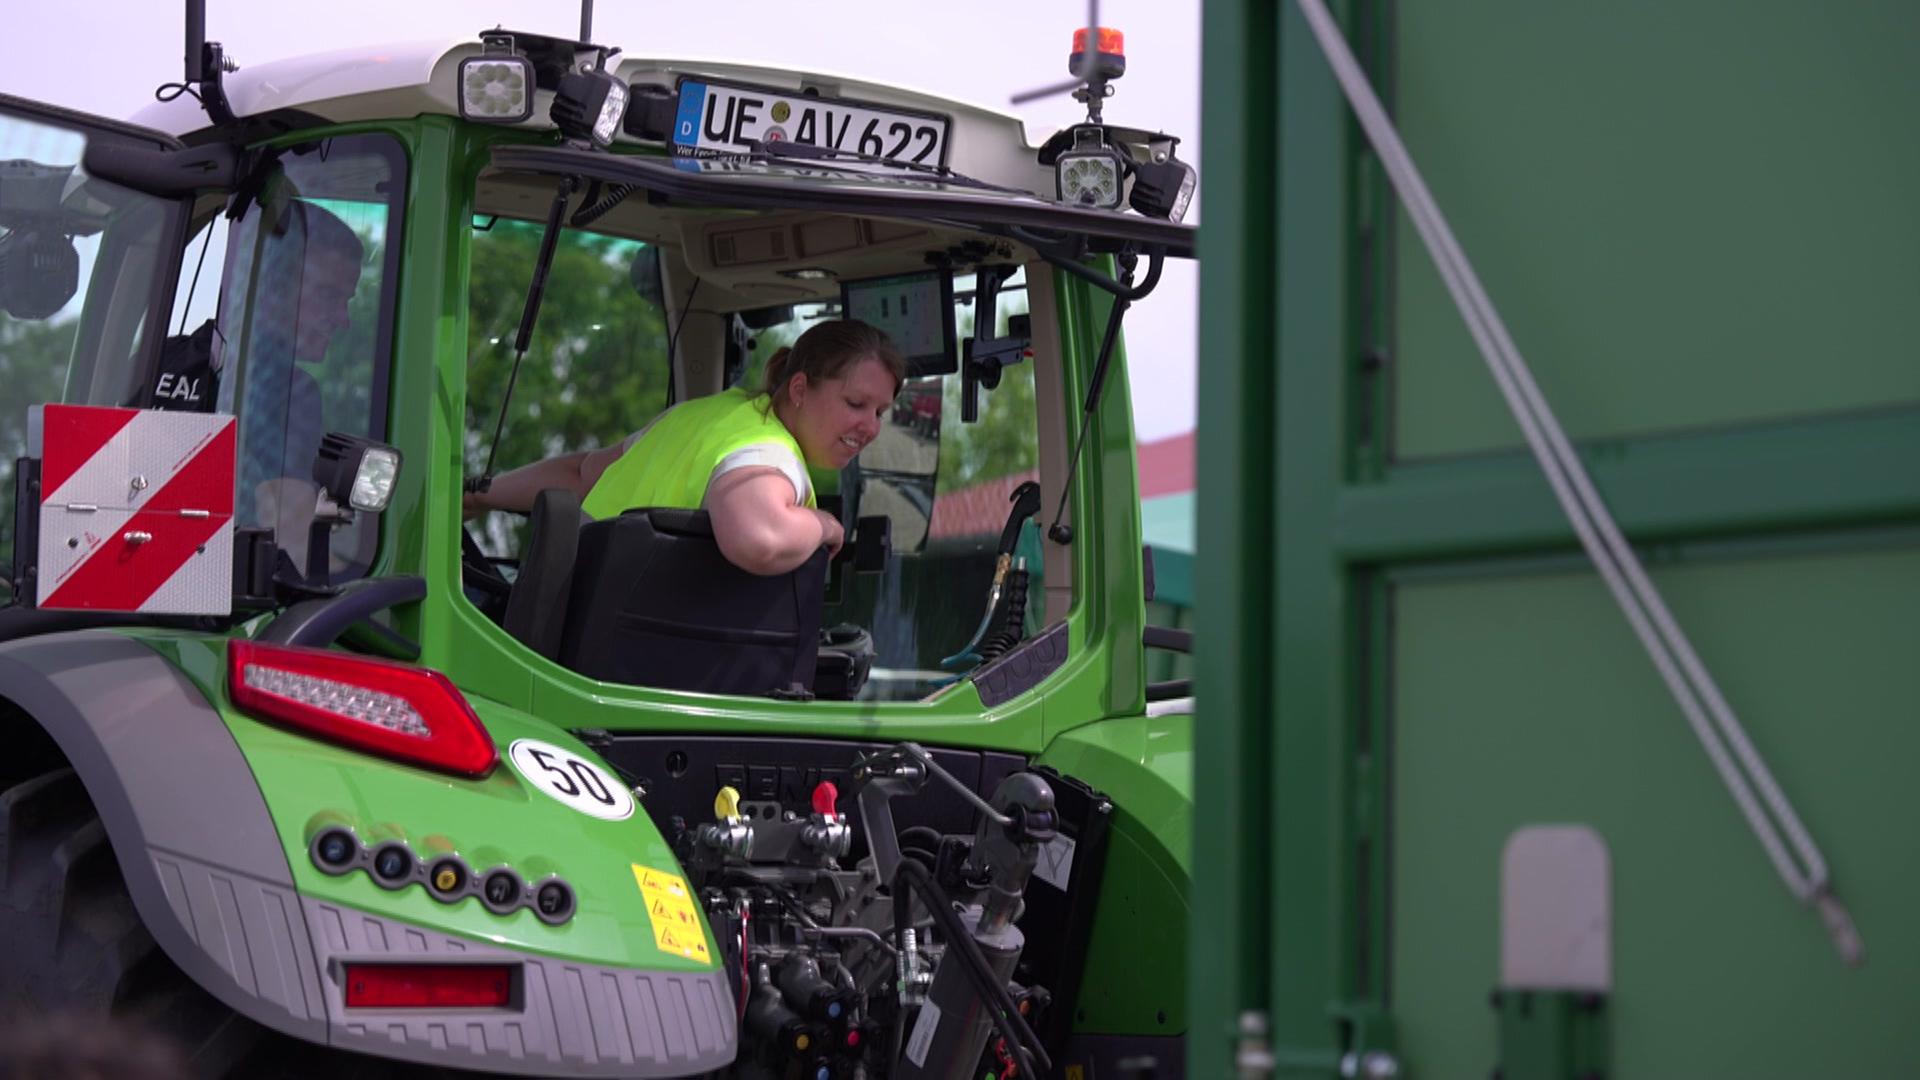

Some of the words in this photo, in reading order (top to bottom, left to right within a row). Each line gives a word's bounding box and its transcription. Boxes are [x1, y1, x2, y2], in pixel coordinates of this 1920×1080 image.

[681, 121, 692, 136] D
[703, 93, 764, 146] UE
[794, 108, 852, 158] AV
[857, 118, 939, 164] 622
[527, 747, 616, 806] 50
